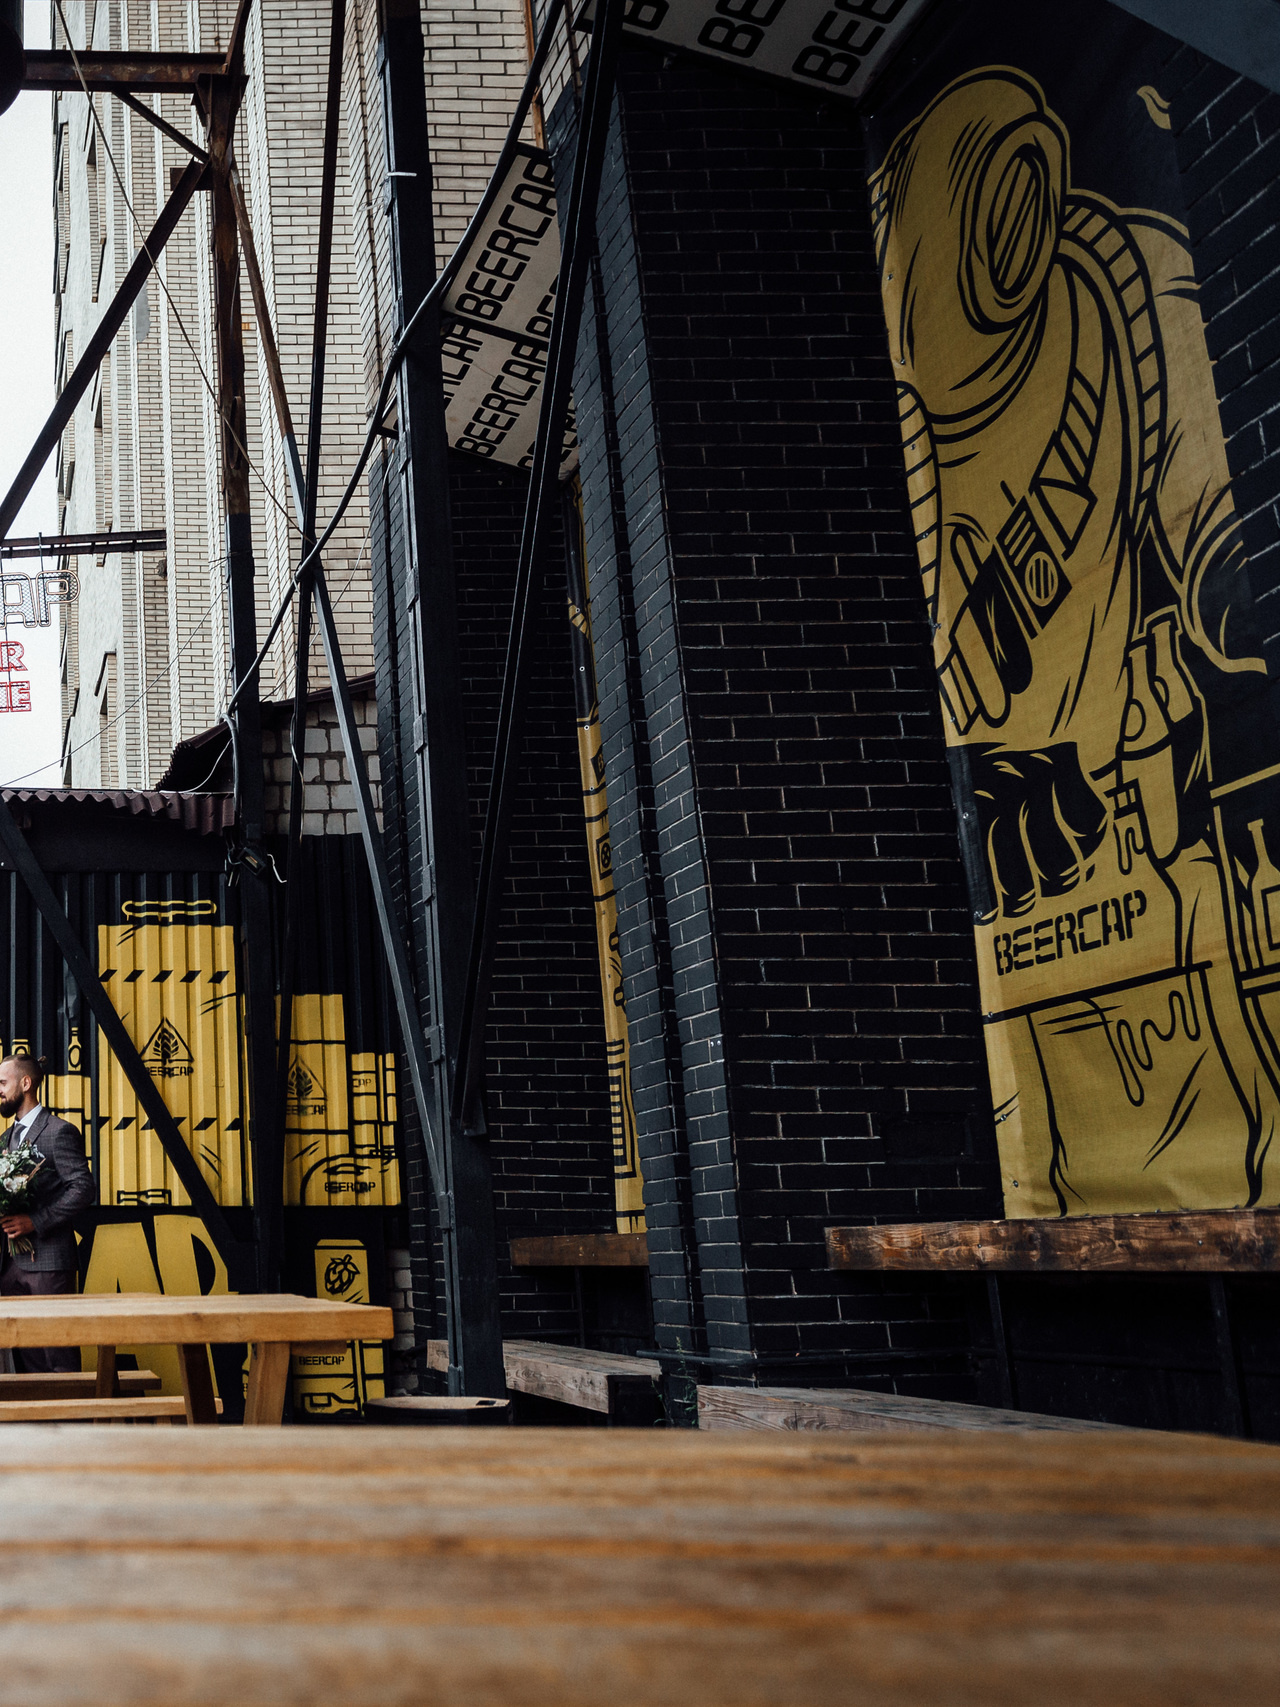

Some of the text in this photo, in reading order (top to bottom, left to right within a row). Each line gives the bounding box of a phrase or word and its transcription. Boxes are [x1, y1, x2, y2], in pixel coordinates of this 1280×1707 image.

[993, 888, 1148, 977] BEERCAP
[146, 1066, 194, 1078] EERCAP
[285, 1104, 327, 1116] EERCAP
[324, 1181, 377, 1194] BEERCAP
[298, 1355, 345, 1366] BEERCAP
